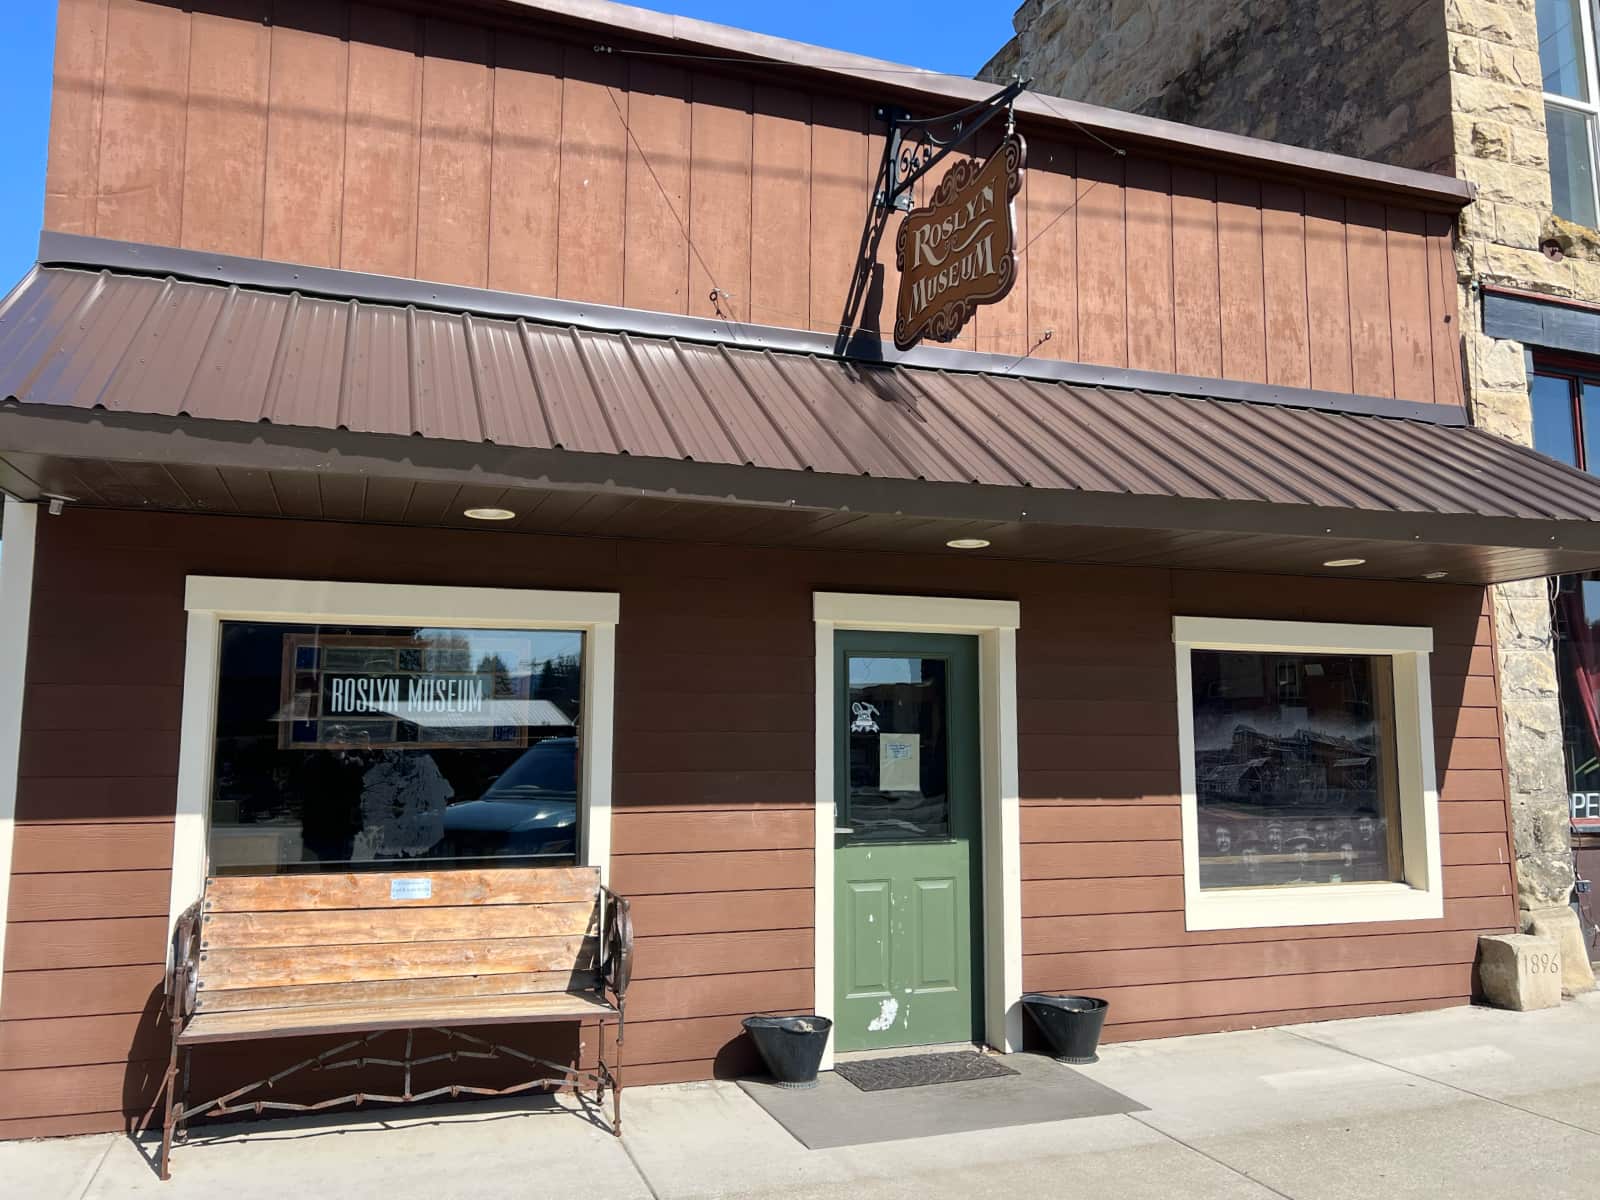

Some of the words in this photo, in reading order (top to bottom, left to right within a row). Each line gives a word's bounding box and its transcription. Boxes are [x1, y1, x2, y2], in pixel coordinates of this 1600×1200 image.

[912, 175, 996, 270] ROSLYN
[907, 232, 996, 322] MUSEUM
[331, 678, 400, 712] ROSLYN
[408, 679, 482, 713] MUSEUM
[1569, 792, 1600, 818] PE
[1523, 952, 1559, 976] 1896
